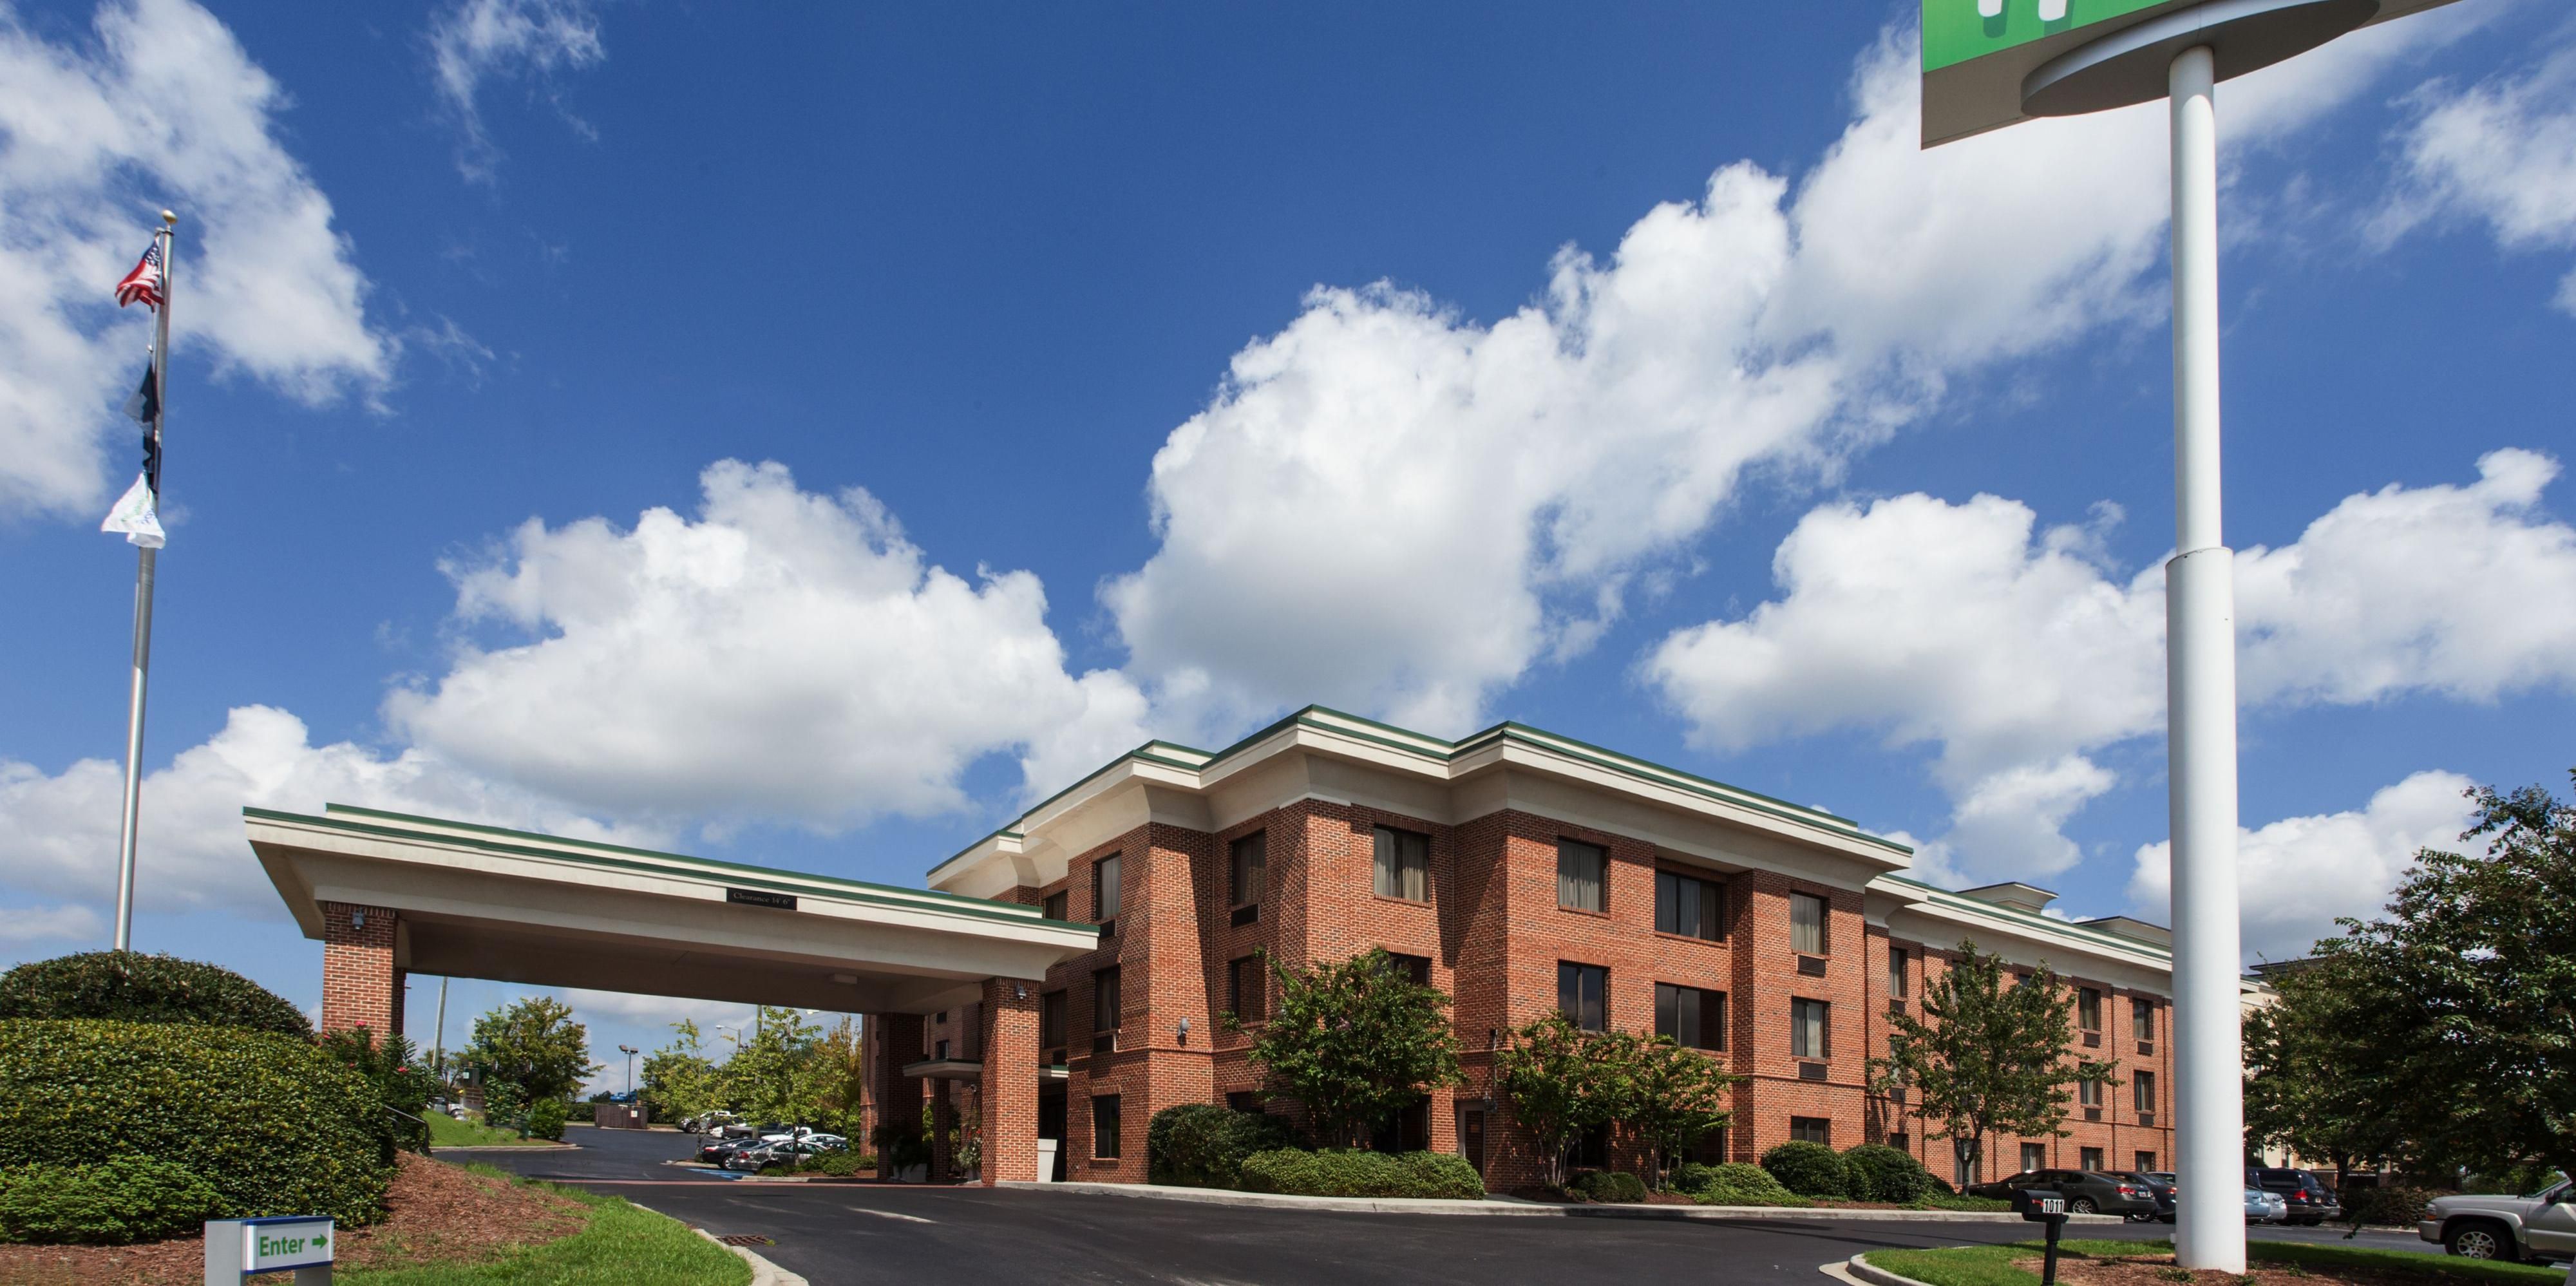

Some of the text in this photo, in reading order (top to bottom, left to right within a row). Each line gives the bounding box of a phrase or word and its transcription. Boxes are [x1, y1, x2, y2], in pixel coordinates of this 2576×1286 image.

[733, 892, 770, 903] Clearance
[2045, 1199, 2063, 1213] 1011
[259, 1236, 306, 1257] Enter
